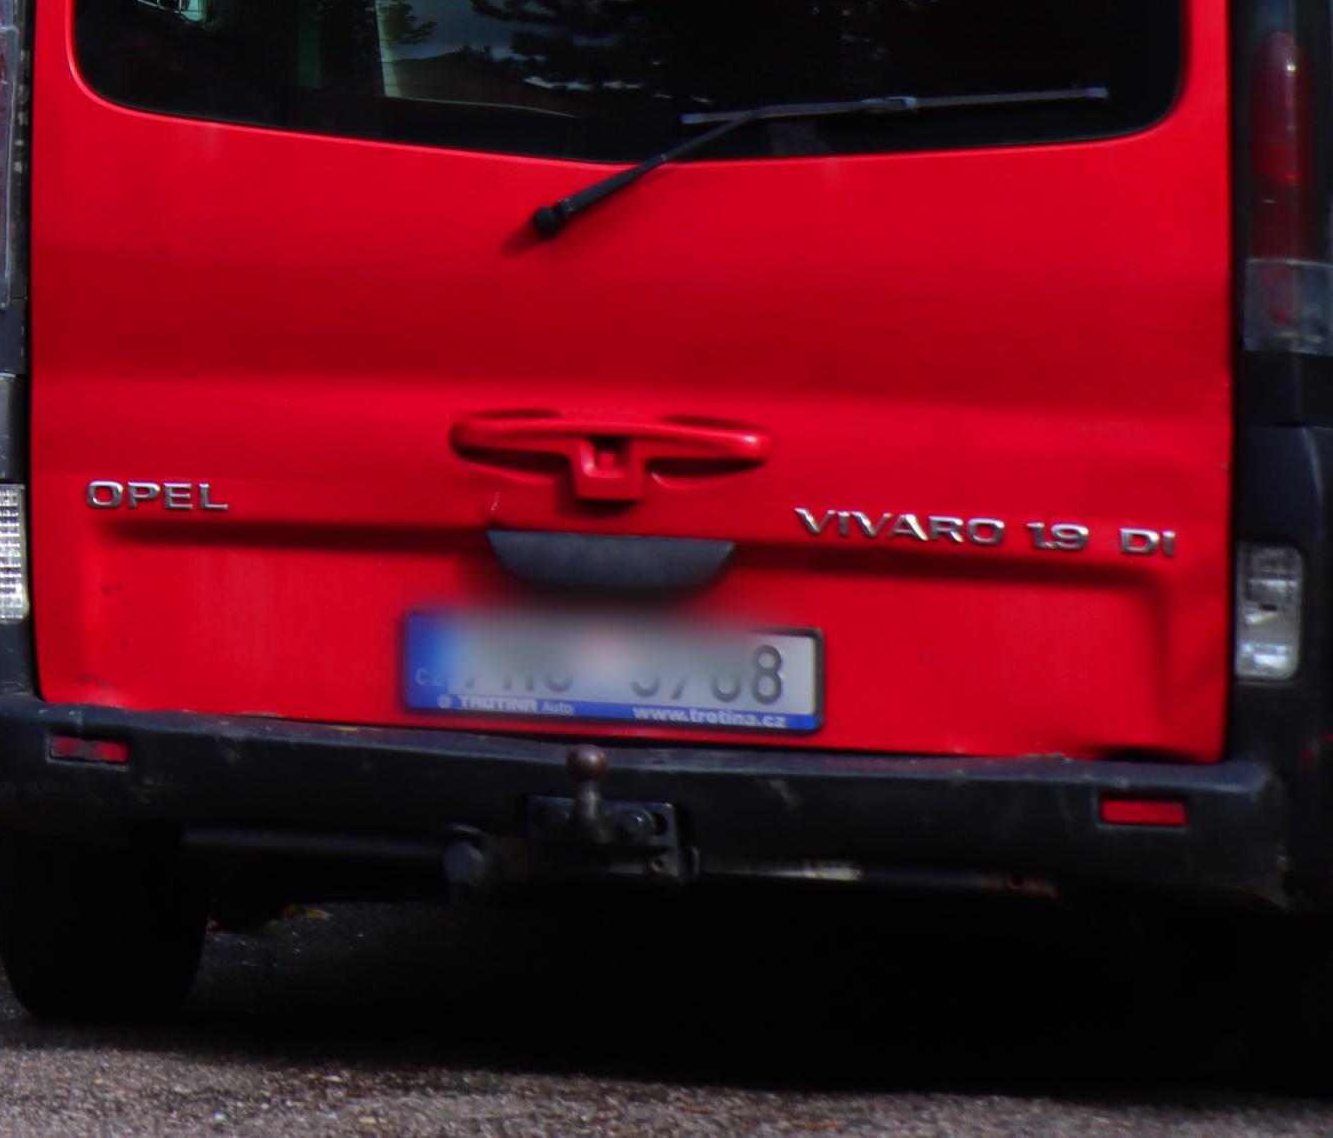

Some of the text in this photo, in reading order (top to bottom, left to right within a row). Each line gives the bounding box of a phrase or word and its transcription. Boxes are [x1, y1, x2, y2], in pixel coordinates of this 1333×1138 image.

[86, 480, 229, 510] OPEL
[794, 507, 1005, 545] VIVARO
[1120, 528, 1176, 557] DI
[632, 706, 787, 729] www.trotina.cz
